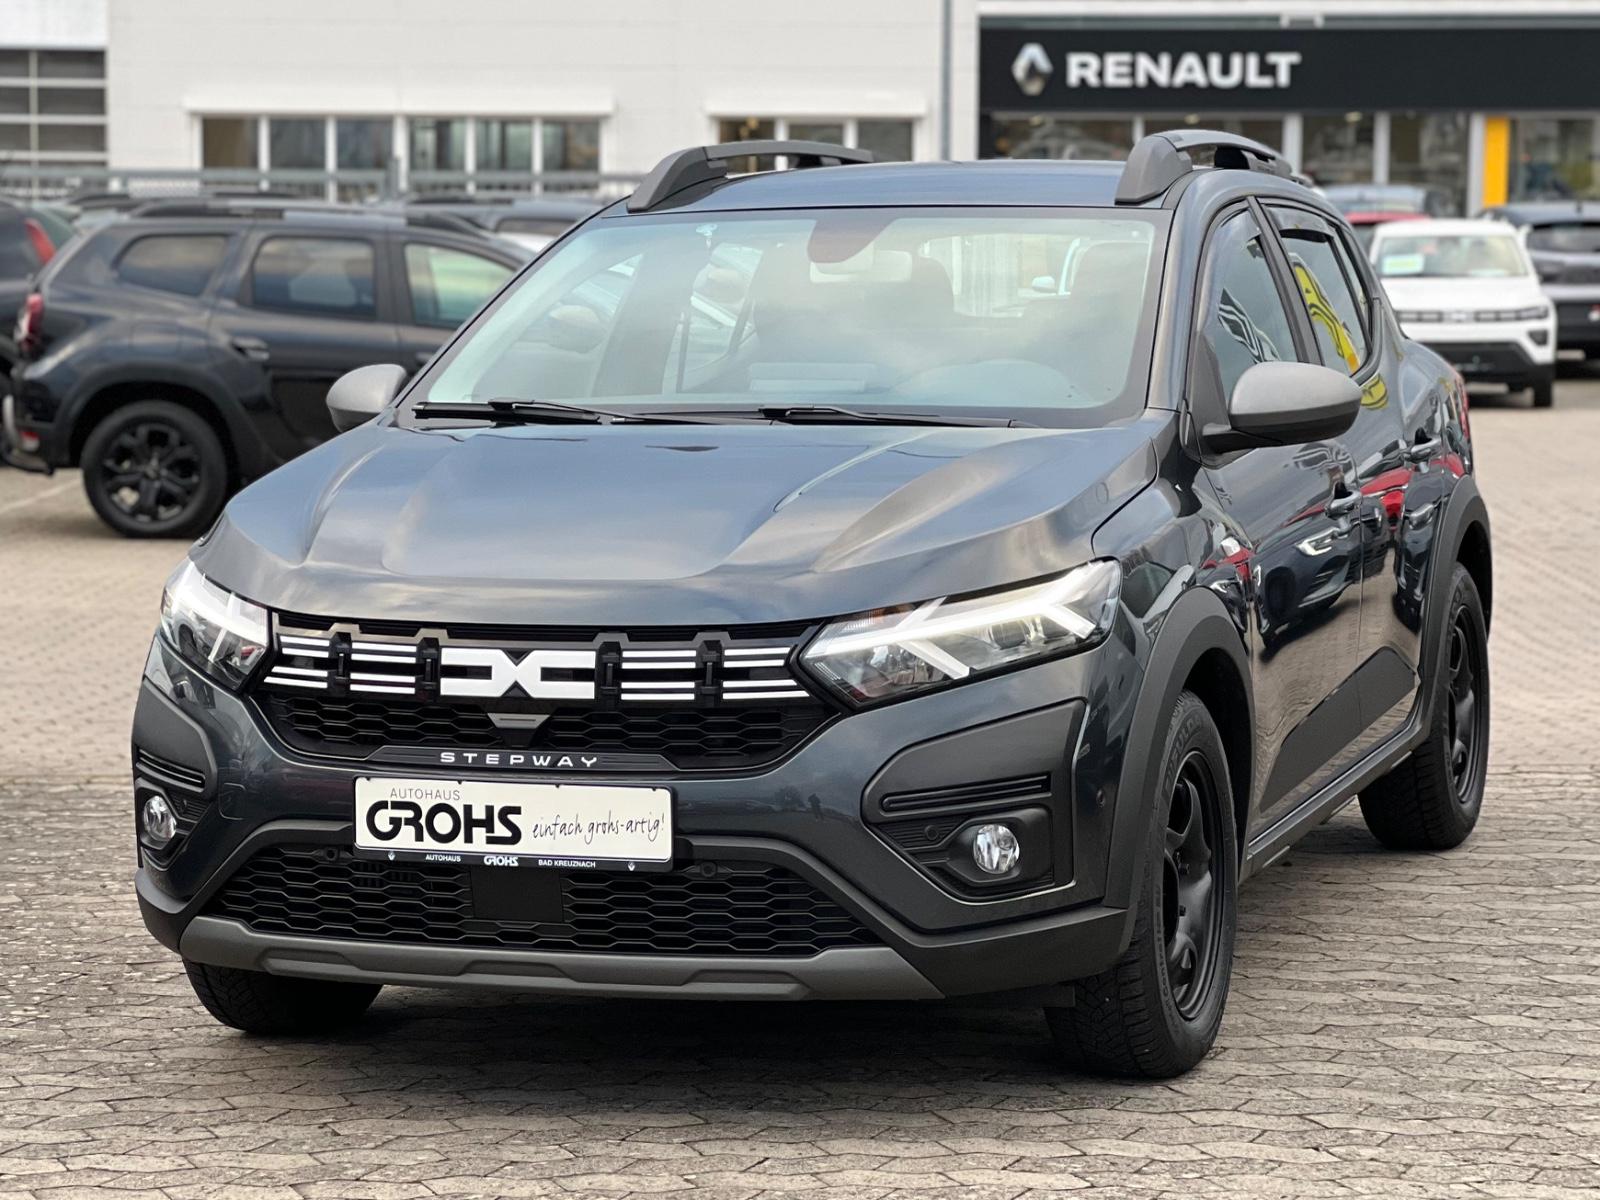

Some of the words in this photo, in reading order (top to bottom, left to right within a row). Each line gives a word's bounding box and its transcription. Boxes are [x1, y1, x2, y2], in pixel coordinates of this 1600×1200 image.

[1066, 52, 1302, 88] RENAULT
[440, 752, 597, 768] STEPWAY
[390, 787, 461, 801] AUTOHAUS
[366, 800, 522, 846] GROHS
[532, 813, 583, 839] einfach
[584, 810, 665, 845] grohs-artig!
[425, 854, 461, 862] AUTOHAUS
[483, 855, 519, 867] GROHS
[538, 859, 553, 867] BAD
[554, 859, 596, 869] KREUZNACH
